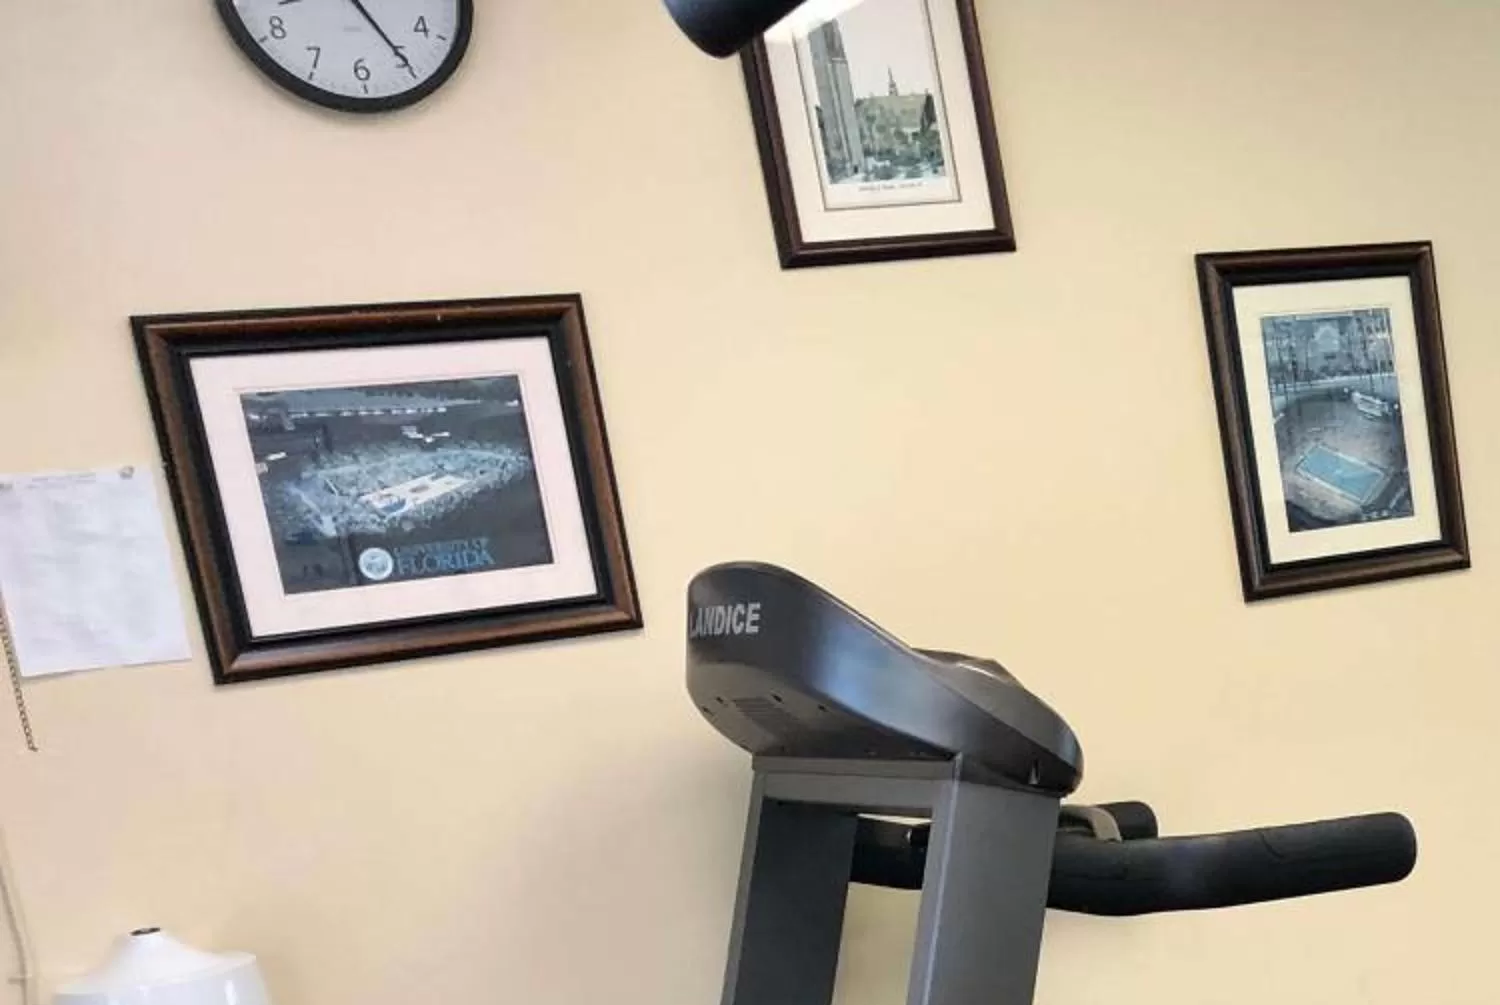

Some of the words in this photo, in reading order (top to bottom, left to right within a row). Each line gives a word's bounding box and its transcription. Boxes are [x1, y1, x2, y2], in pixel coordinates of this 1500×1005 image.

[269, 15, 287, 40] 8
[413, 15, 430, 38] 4
[306, 46, 321, 69] 7
[353, 58, 371, 81] 6
[689, 602, 761, 638] LANDICE
